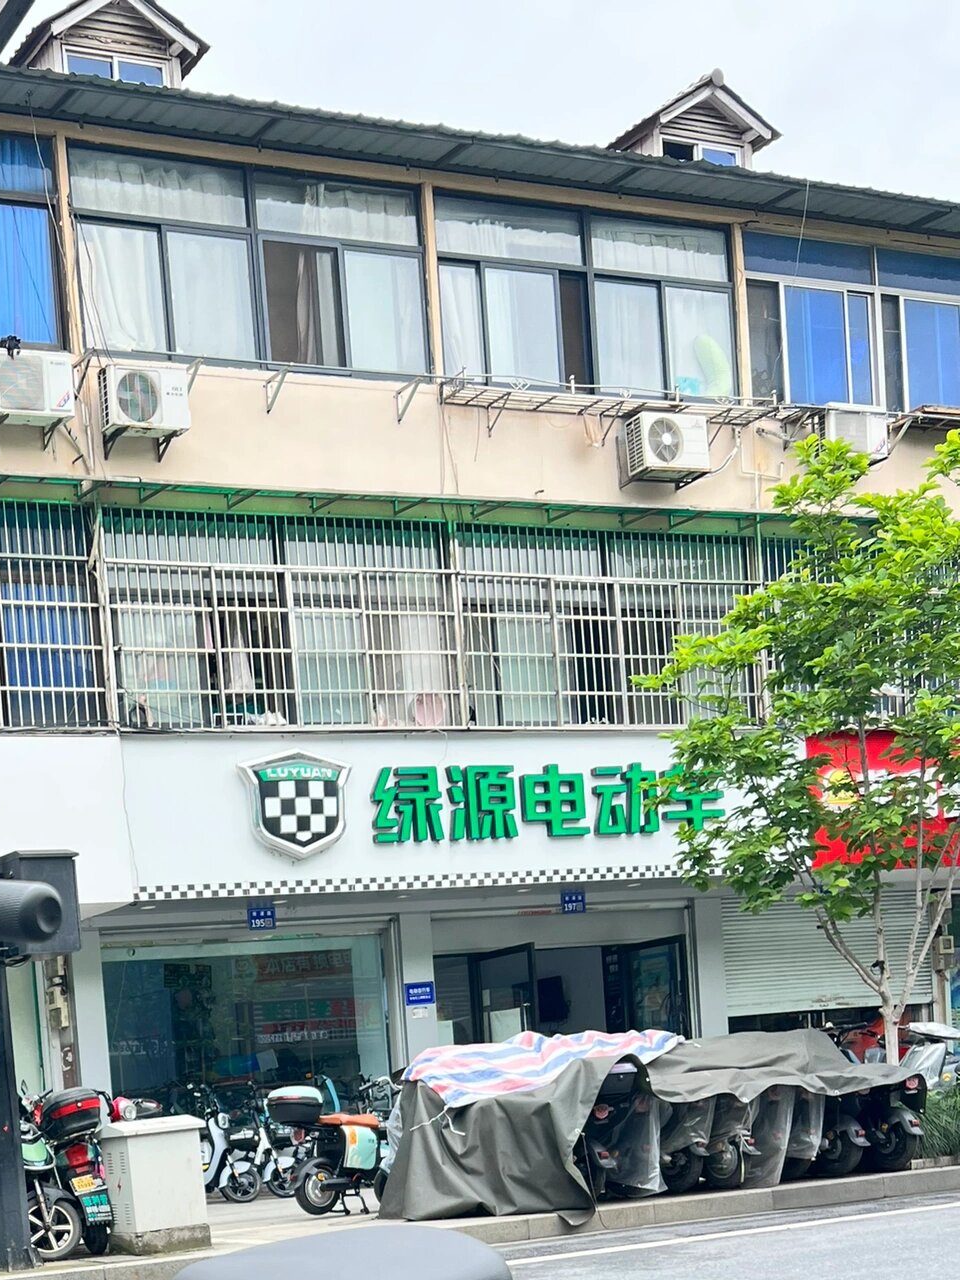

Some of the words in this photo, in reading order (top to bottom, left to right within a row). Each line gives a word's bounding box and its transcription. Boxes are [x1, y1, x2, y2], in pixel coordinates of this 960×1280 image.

[265, 766, 333, 779] LUYUAN
[371, 762, 727, 843] 绿源电动车
[252, 919, 265, 928] 195
